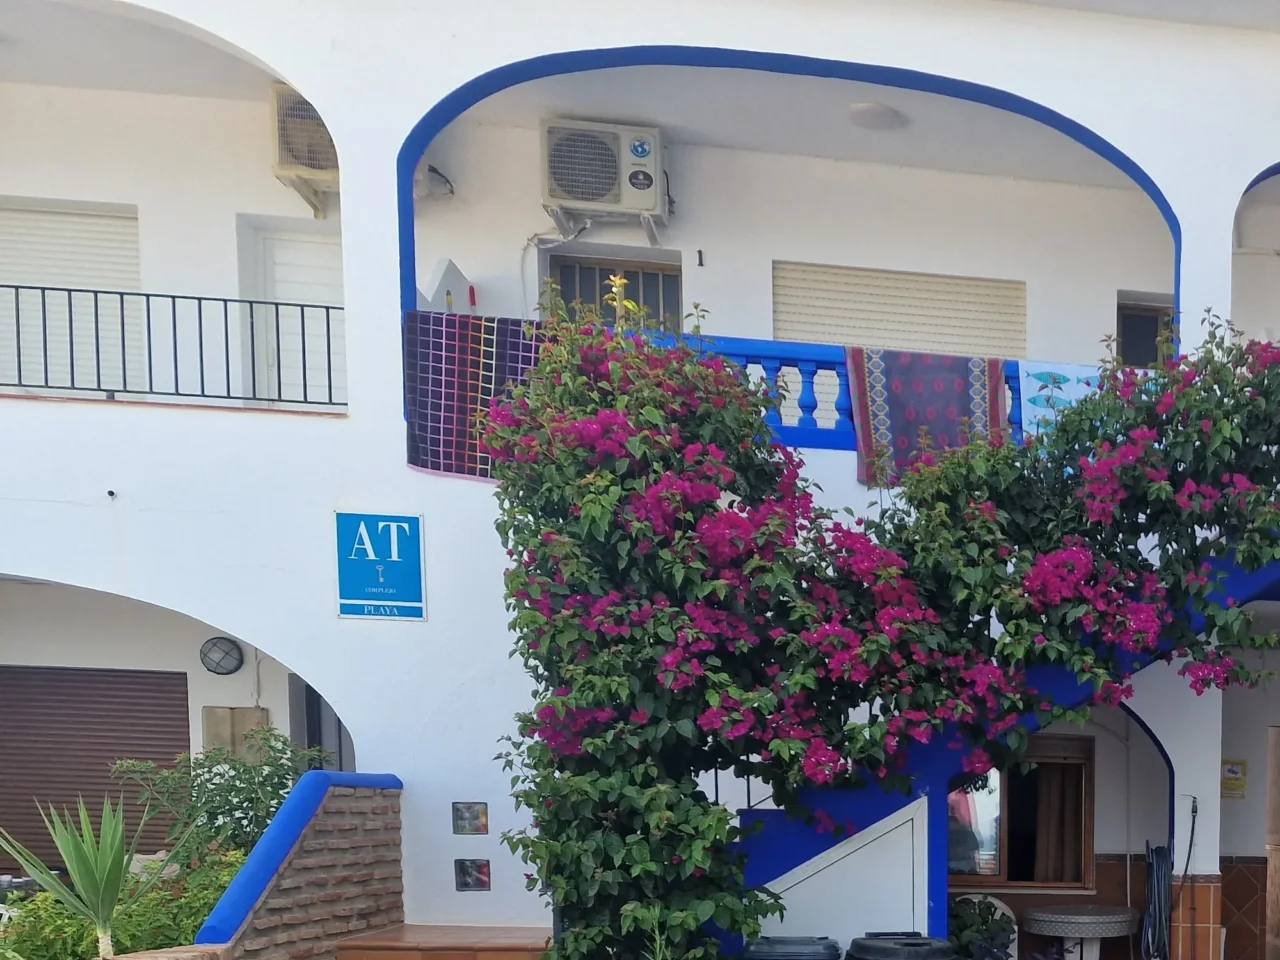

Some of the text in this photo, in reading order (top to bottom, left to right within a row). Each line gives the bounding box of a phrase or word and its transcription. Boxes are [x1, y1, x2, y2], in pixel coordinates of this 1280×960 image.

[696, 249, 705, 267] 1
[348, 520, 410, 562] AT
[364, 605, 399, 616] PLAYA
